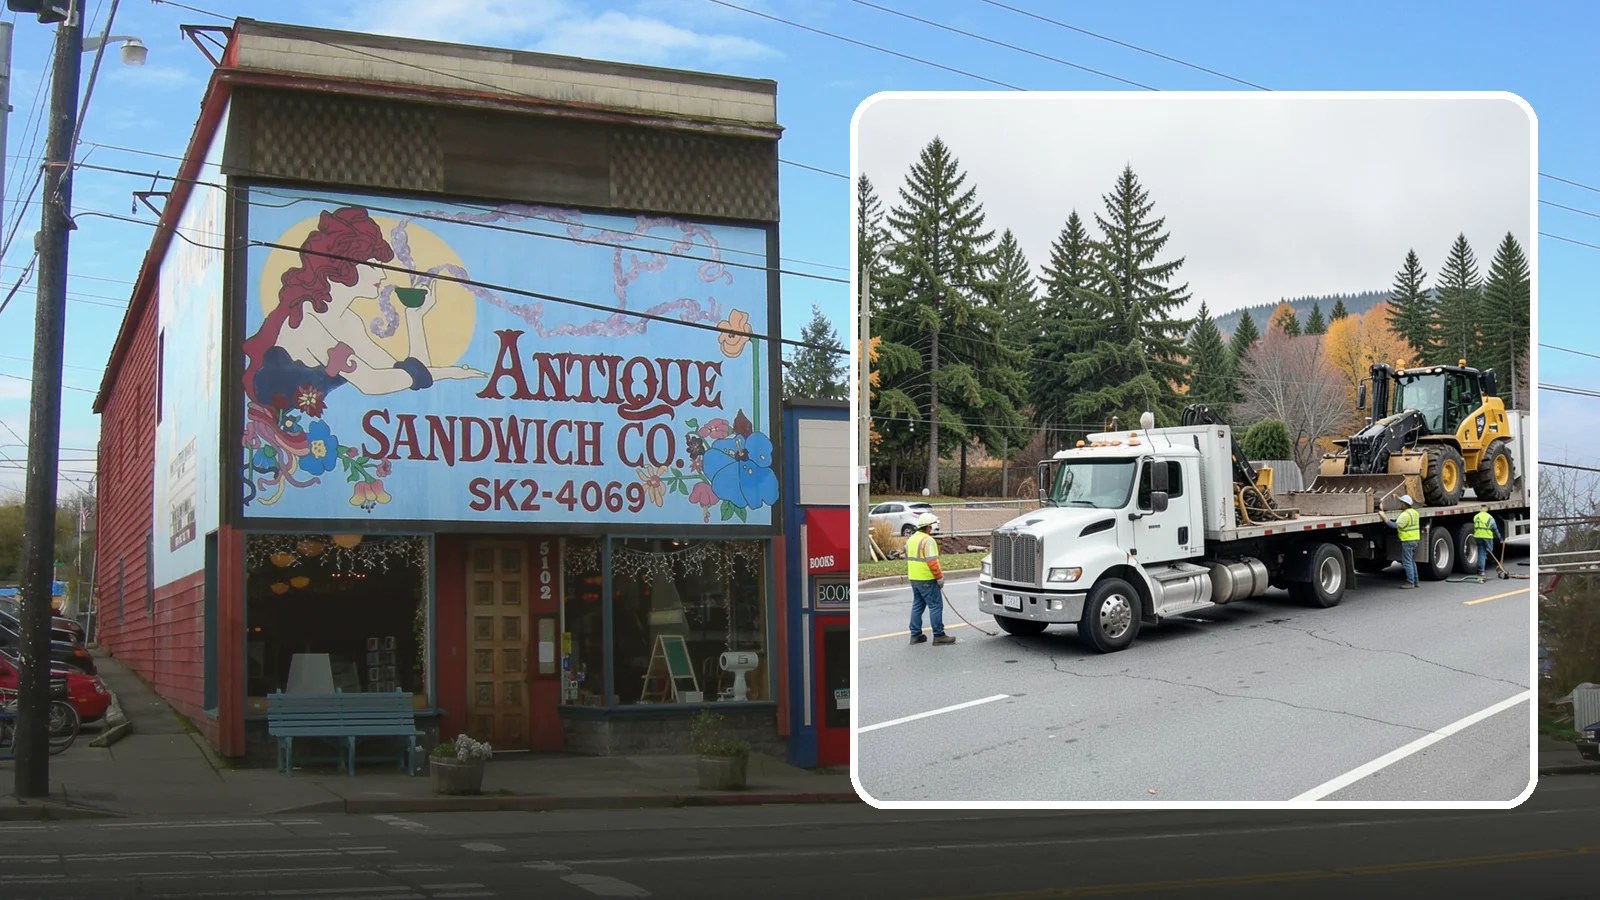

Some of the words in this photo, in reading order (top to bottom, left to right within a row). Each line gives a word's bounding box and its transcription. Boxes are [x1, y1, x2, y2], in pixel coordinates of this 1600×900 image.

[476, 329, 723, 421] ANTIQUE
[361, 409, 605, 467] SANDWICH
[616, 422, 685, 469] CO.
[468, 478, 645, 513] SK2-4069
[540, 541, 551, 600] 5102
[809, 555, 835, 569] BOOKS
